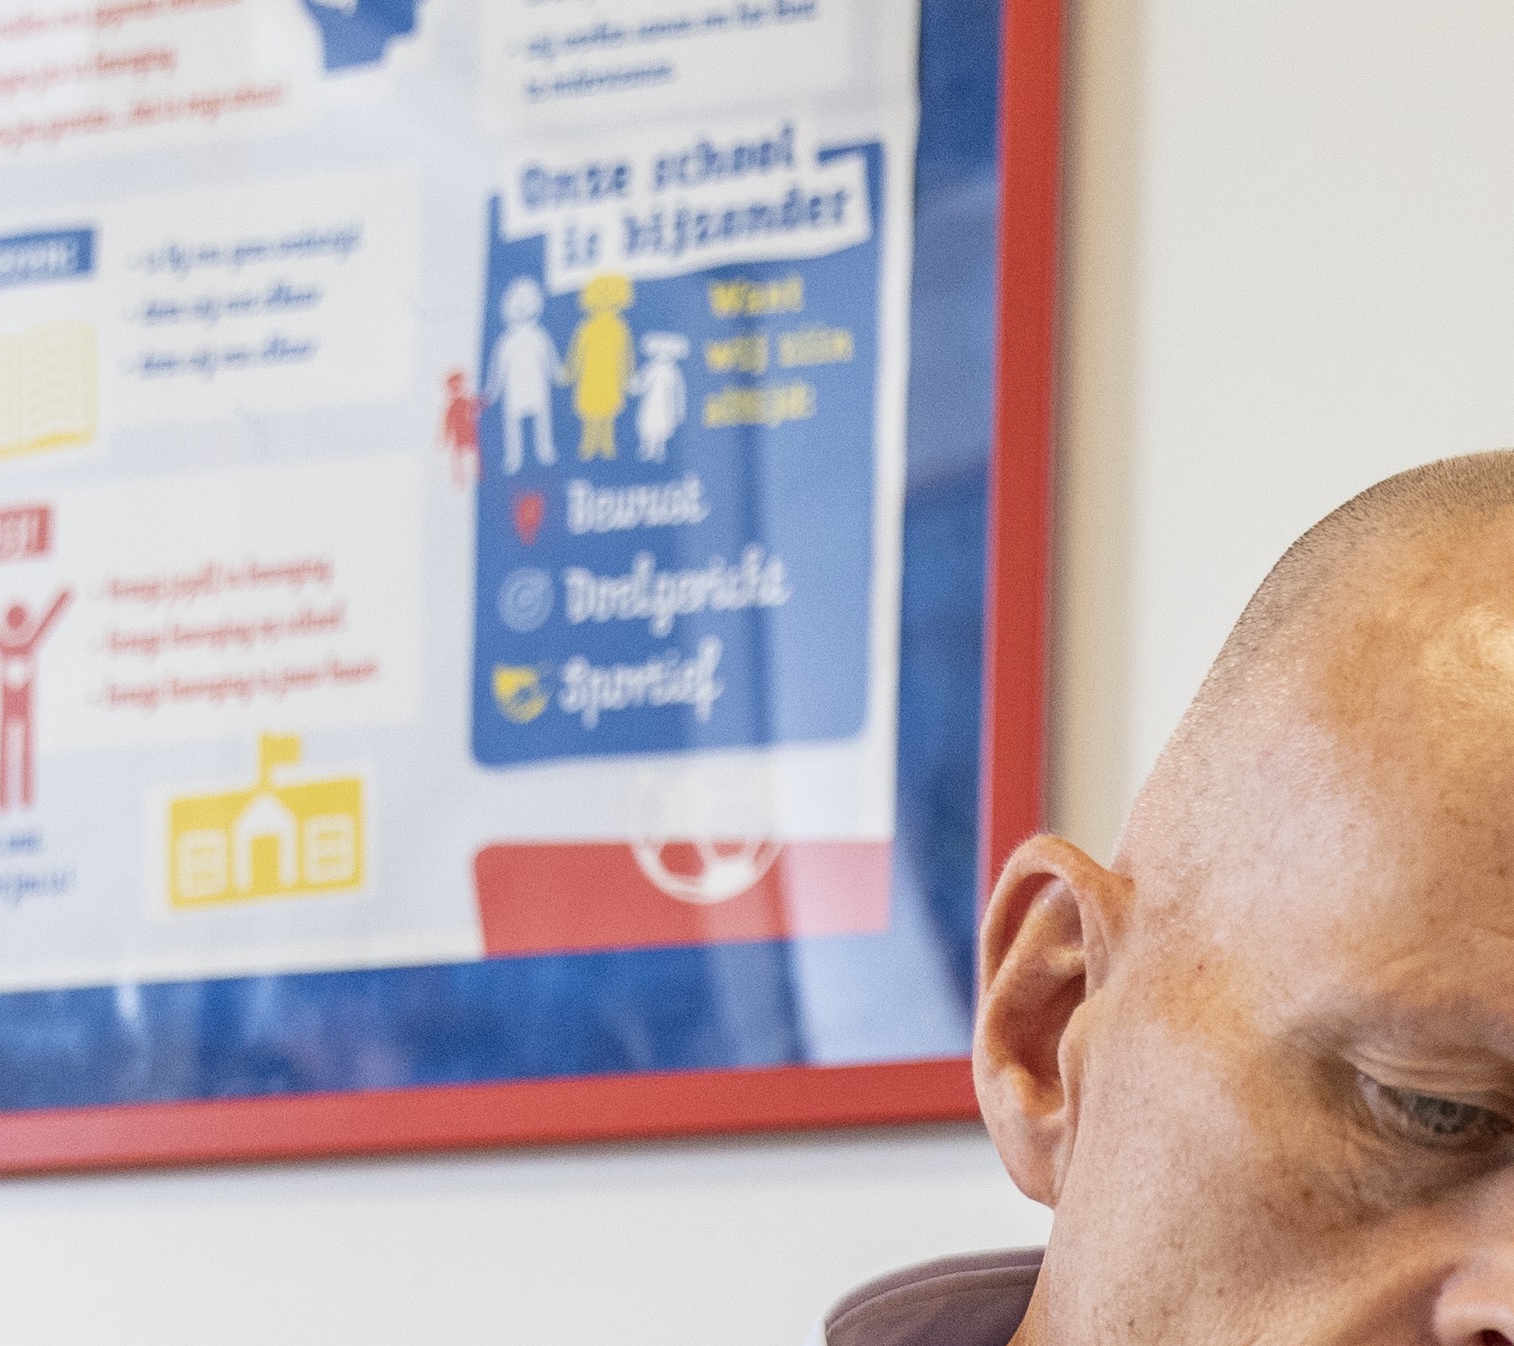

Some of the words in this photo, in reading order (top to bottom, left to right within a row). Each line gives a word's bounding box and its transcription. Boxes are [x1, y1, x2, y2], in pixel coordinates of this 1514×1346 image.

[522, 162, 630, 208] Onze
[655, 127, 796, 189] school
[624, 186, 852, 257] bijzonder
